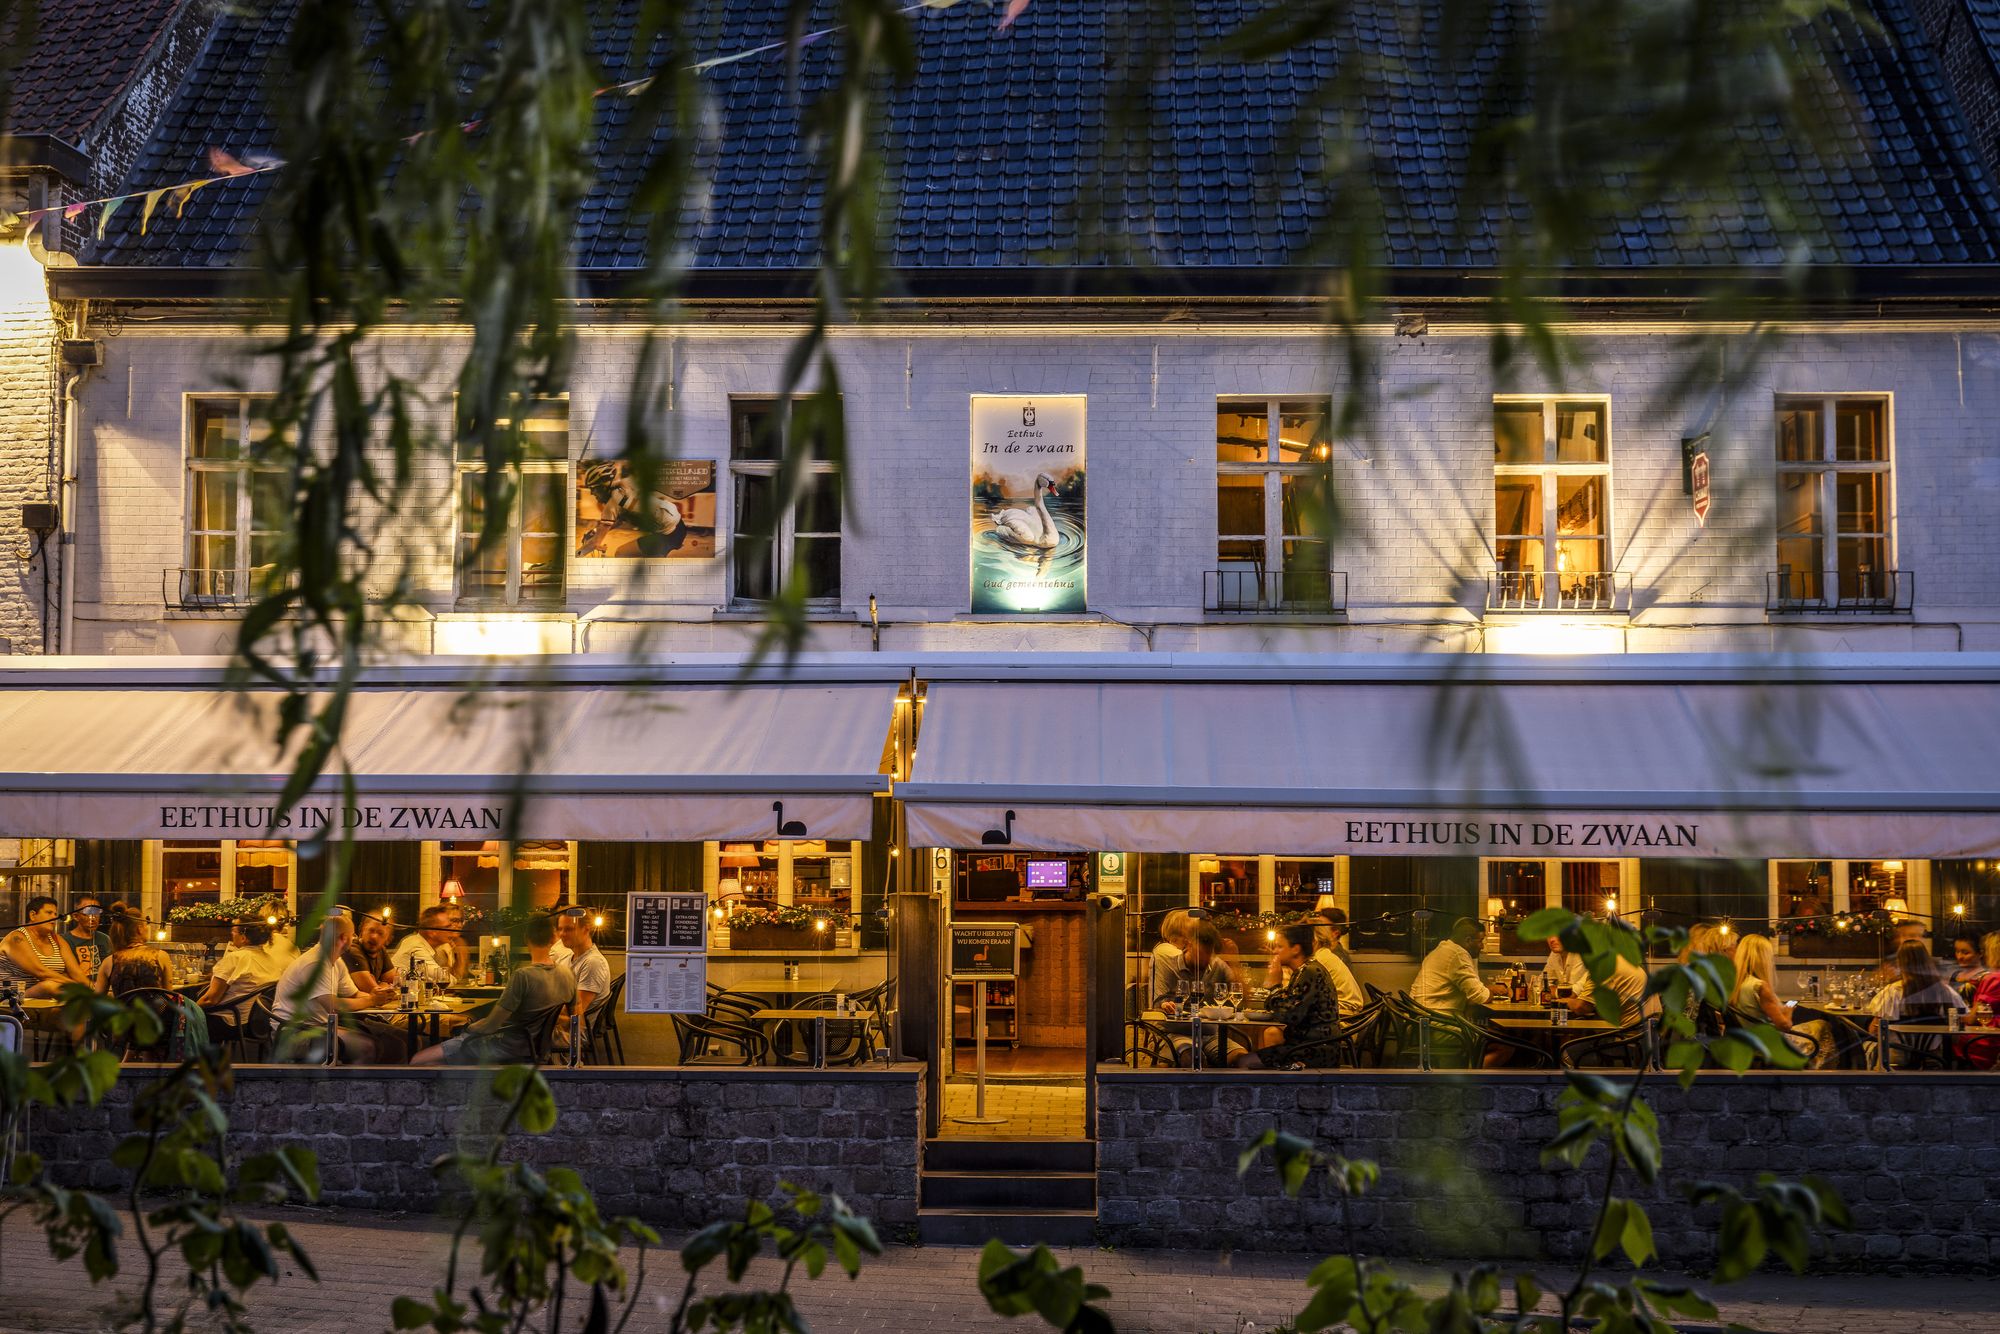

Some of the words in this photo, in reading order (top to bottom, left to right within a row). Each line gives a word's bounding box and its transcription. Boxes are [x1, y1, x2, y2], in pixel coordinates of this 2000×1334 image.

[1007, 429, 1044, 438] Eethuis
[983, 443, 998, 453] In
[1004, 440, 1021, 453] de
[1026, 444, 1075, 453] zwaan
[983, 579, 1004, 588] Oud
[160, 806, 292, 828] EETHUIS
[298, 806, 333, 828] IN
[341, 807, 382, 828] DE
[389, 807, 503, 829] ZWAAN
[1345, 821, 1480, 845] EETHUIS
[1488, 823, 1521, 845] IN
[1531, 824, 1574, 846] DE
[1581, 824, 1699, 847] ZWAAN
[936, 847, 947, 869] 6
